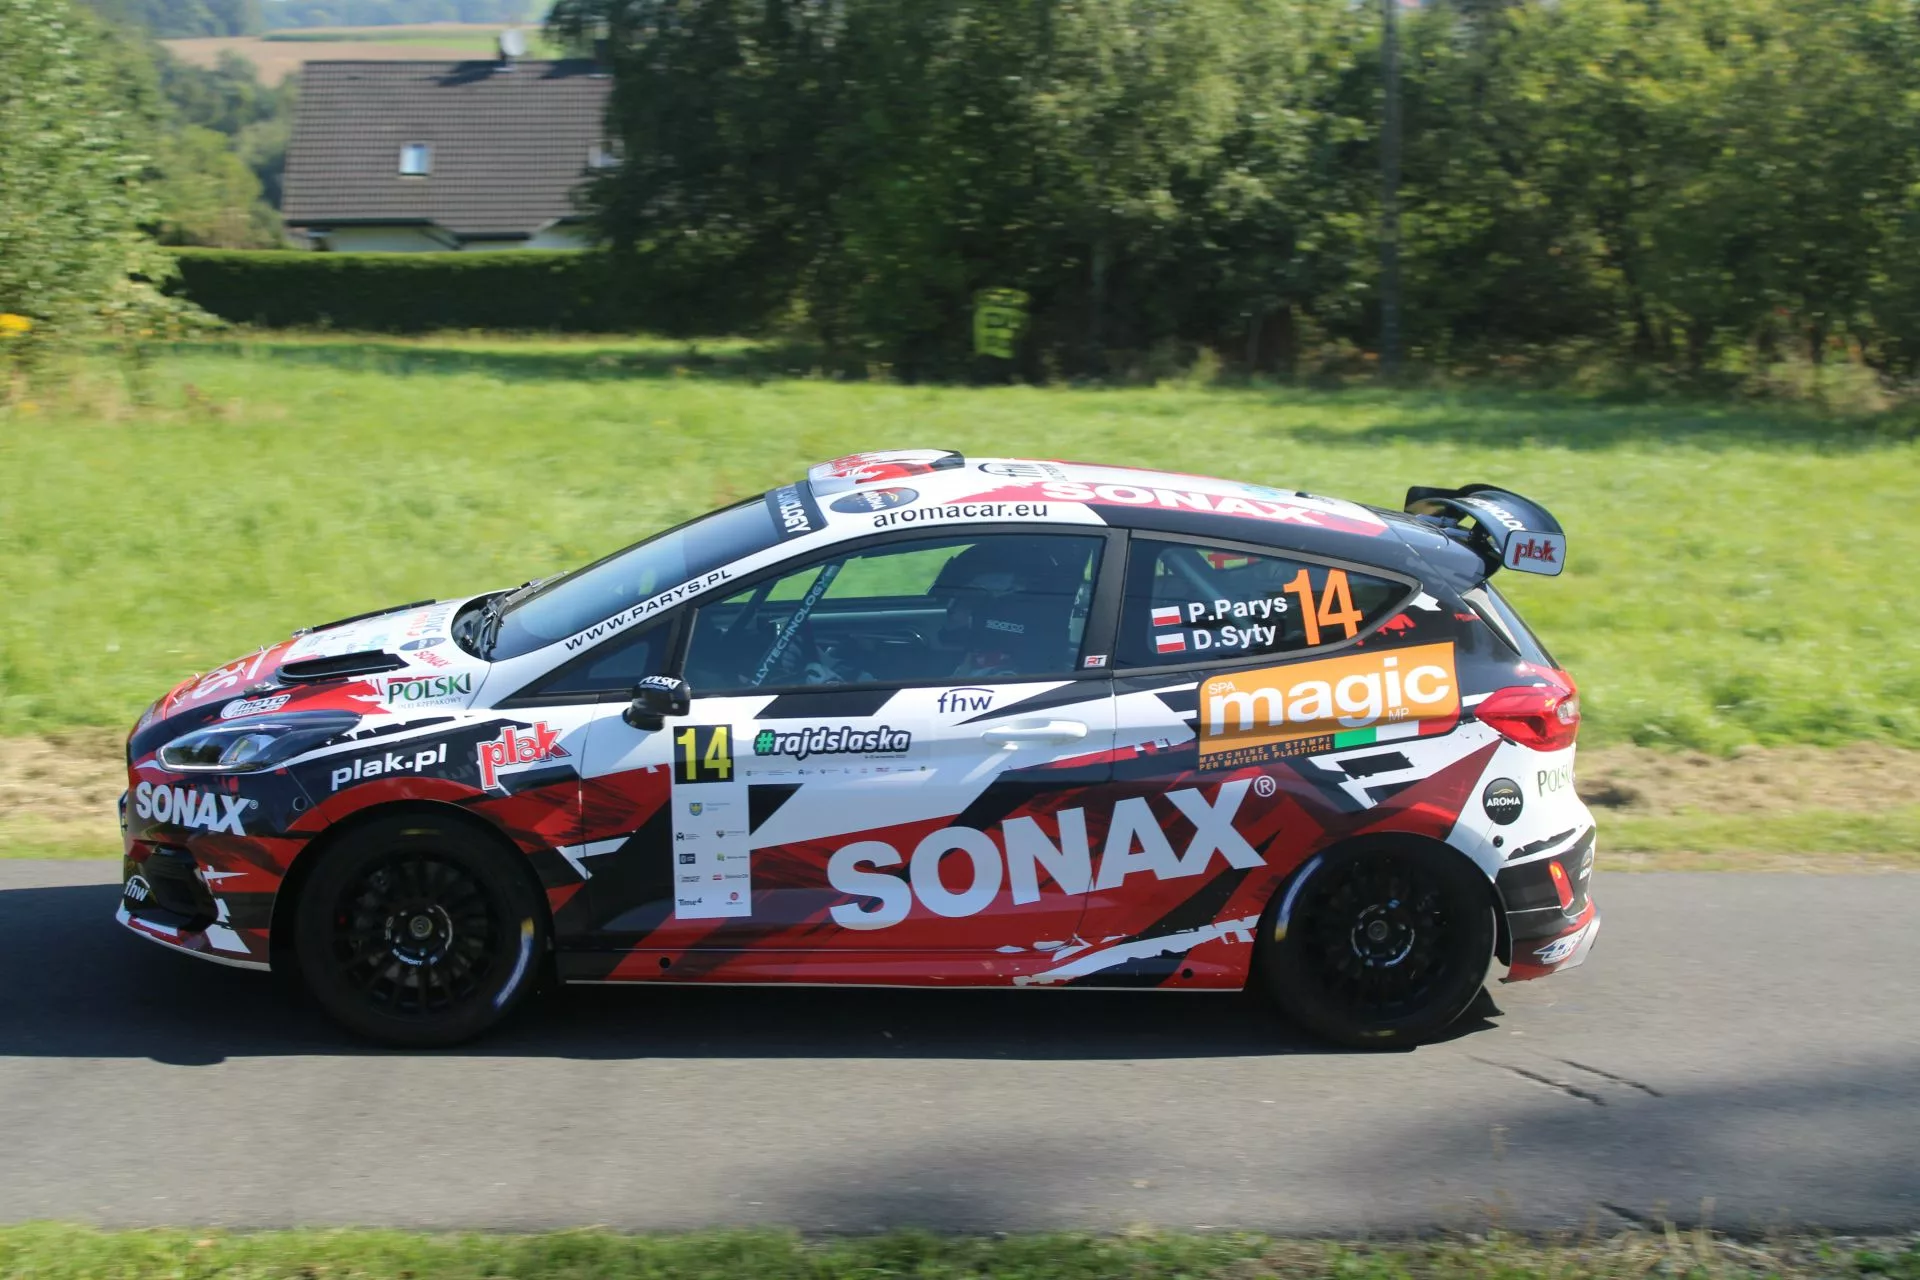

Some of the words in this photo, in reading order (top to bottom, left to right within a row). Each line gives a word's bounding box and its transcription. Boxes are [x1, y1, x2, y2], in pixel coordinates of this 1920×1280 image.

[873, 502, 1048, 528] aromacar.eu
[1041, 480, 1325, 526] SONAX
[1512, 538, 1557, 566] plak
[564, 569, 733, 651] WWW.PARYS.PL
[1188, 594, 1289, 623] P.Parys
[1282, 568, 1363, 646] 14
[1193, 622, 1277, 651] D.Syty
[387, 672, 473, 705] POLSKI
[937, 688, 994, 714] fhw
[1207, 680, 1236, 694] SPA
[1209, 656, 1450, 736] magic
[1388, 708, 1409, 722] MP
[476, 719, 572, 791] plak
[676, 726, 732, 781] 14
[754, 725, 911, 760] #rajdslaska
[1199, 747, 1264, 764] MACCHINE
[1271, 744, 1278, 752] E
[1285, 737, 1331, 750] STAMPI
[331, 743, 448, 791] plak.pl
[1199, 762, 1220, 771] PER
[1223, 754, 1269, 767] MATERIE
[1273, 744, 1332, 758] PLASTICHE
[1486, 796, 1521, 808] AROMA
[124, 875, 151, 902] fhw
